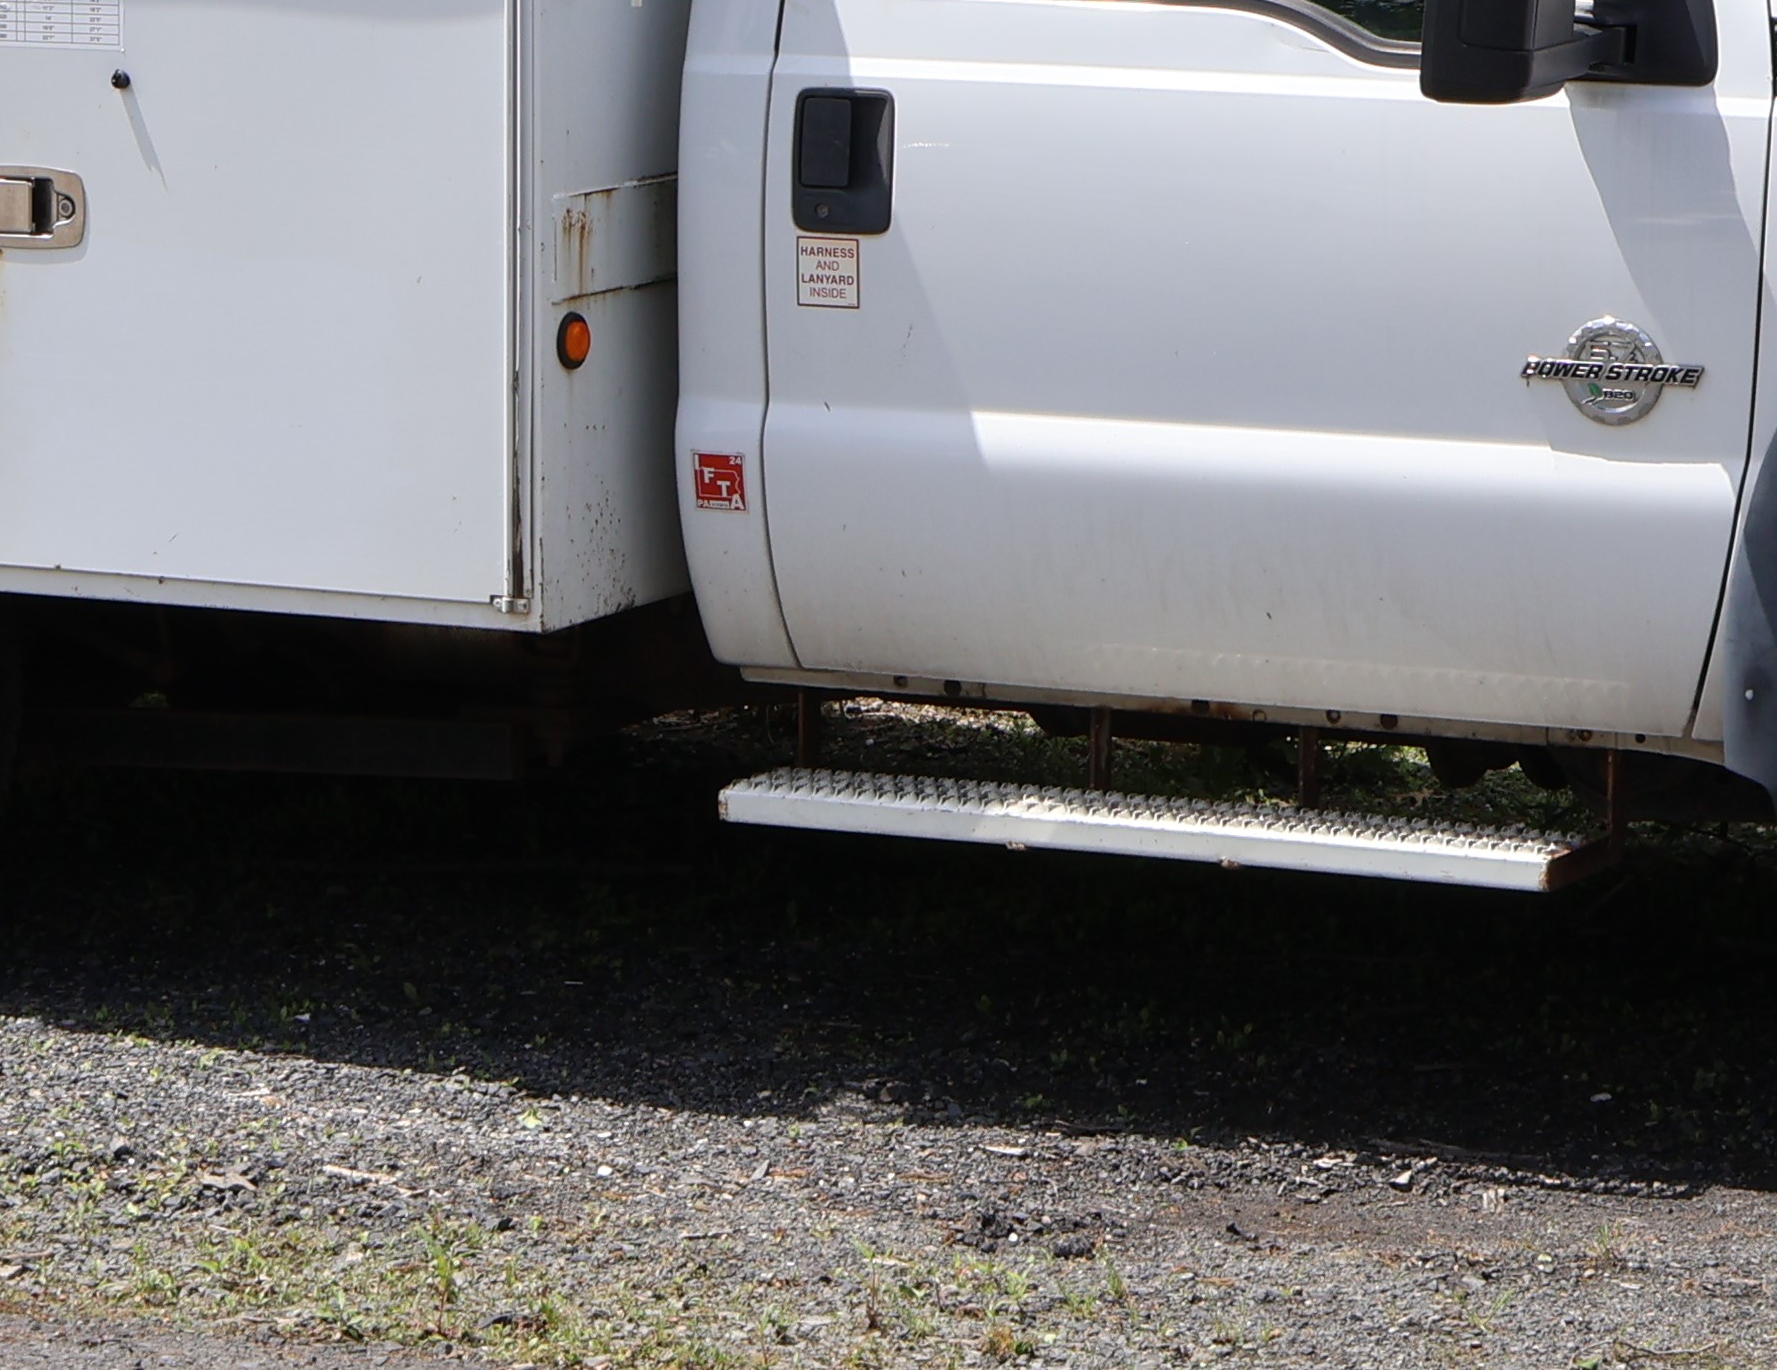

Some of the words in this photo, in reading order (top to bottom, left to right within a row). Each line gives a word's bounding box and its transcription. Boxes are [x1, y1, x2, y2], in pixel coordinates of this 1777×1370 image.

[800, 246, 855, 259] HARNESS
[815, 260, 840, 271] AND
[801, 273, 855, 286] LANYARD
[809, 286, 847, 299] INSIDE
[1522, 360, 1604, 381] POWER
[1603, 364, 1703, 387] STROKE
[1602, 389, 1635, 401] B20
[729, 456, 742, 466] 24
